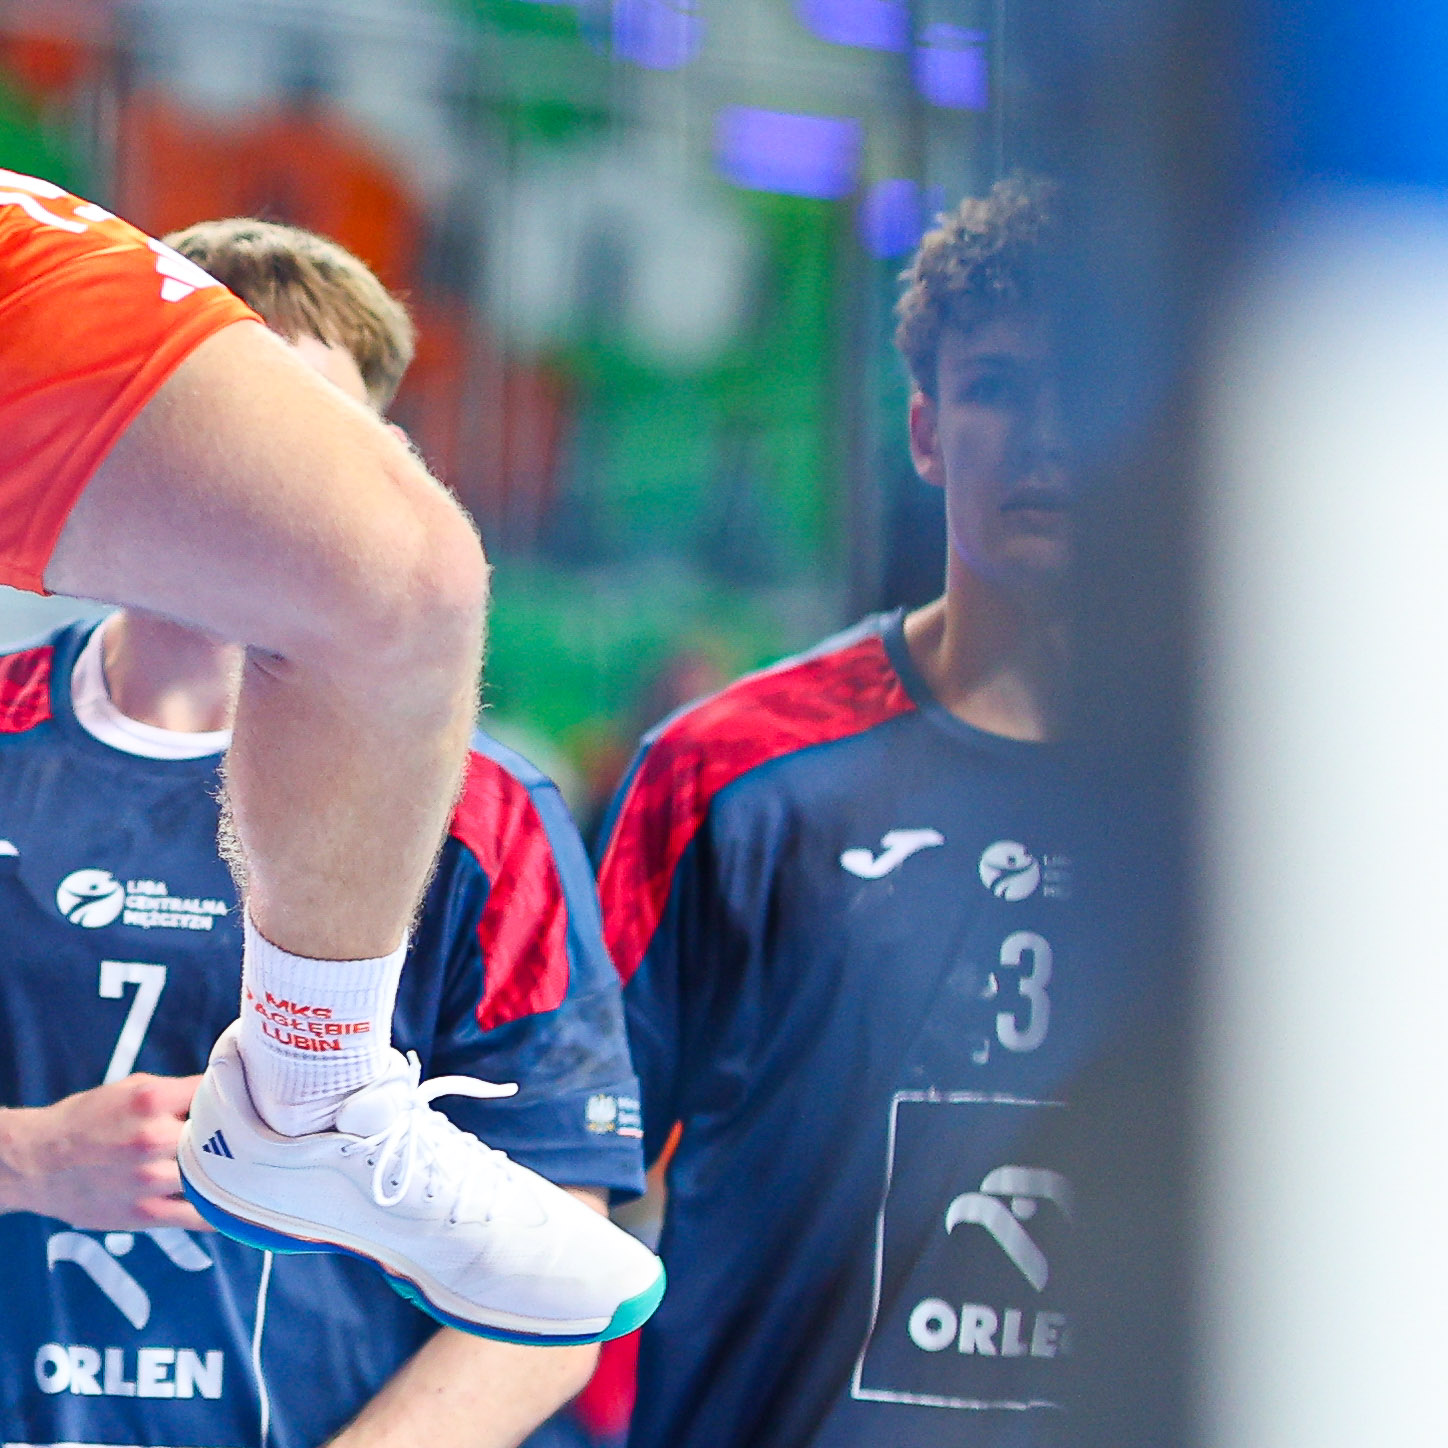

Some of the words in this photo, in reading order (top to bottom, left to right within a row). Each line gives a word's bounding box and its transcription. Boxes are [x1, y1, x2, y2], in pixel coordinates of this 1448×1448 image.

[98, 959, 168, 1086] 7
[246, 985, 371, 1039] AGŁĘBIE
[264, 990, 333, 1020] MKS
[261, 1021, 343, 1053] LUBIN
[907, 1296, 1072, 1358] ORLE
[33, 1342, 225, 1400] ORLEN
